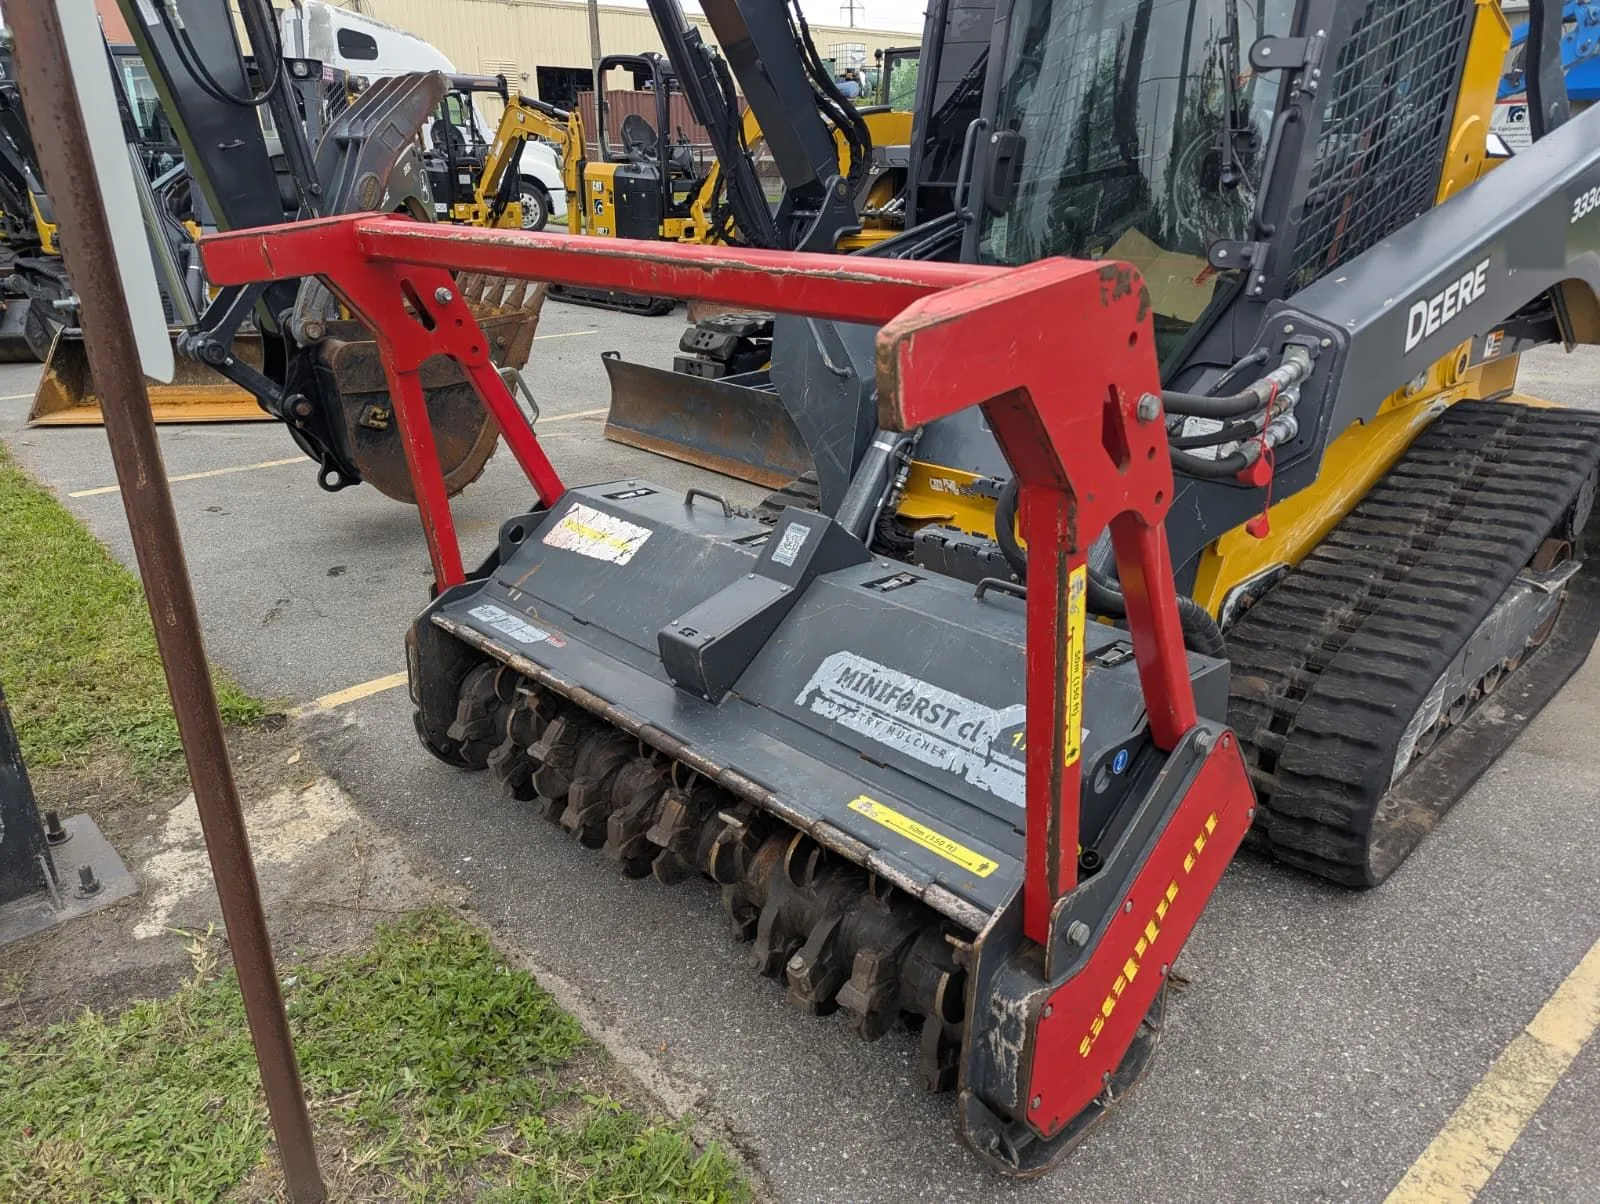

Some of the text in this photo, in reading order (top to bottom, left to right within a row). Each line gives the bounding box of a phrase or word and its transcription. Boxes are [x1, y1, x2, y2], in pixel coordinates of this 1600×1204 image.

[1404, 258, 1491, 354] DEERE
[820, 697, 948, 760] ORSTRY MULCHER
[835, 666, 961, 730] MINIFORST
[909, 824, 958, 853] 50m (150 ft)
